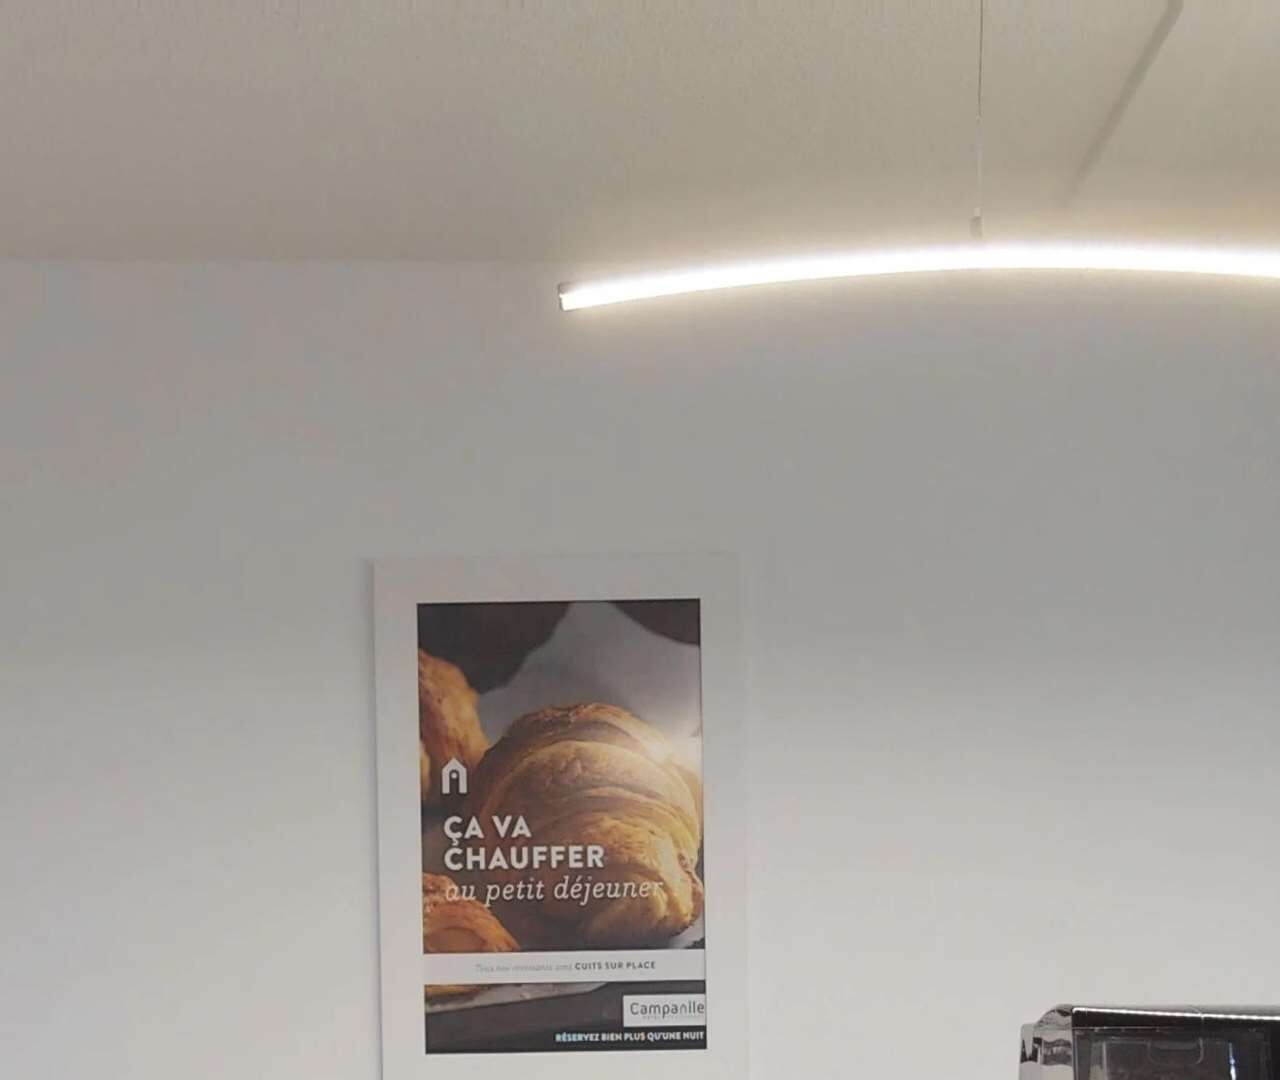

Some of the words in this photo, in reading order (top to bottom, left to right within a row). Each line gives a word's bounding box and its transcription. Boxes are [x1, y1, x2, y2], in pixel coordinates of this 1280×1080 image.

[444, 816, 484, 845] ÇA
[492, 816, 532, 838] VA
[444, 846, 605, 870] CHAUFFER
[446, 887, 477, 901] au
[485, 878, 545, 906] petit
[554, 876, 664, 905] déjeuner
[626, 961, 656, 970] PLACE
[624, 1031, 646, 1042] PLUS
[683, 1031, 705, 1041] NUIT
